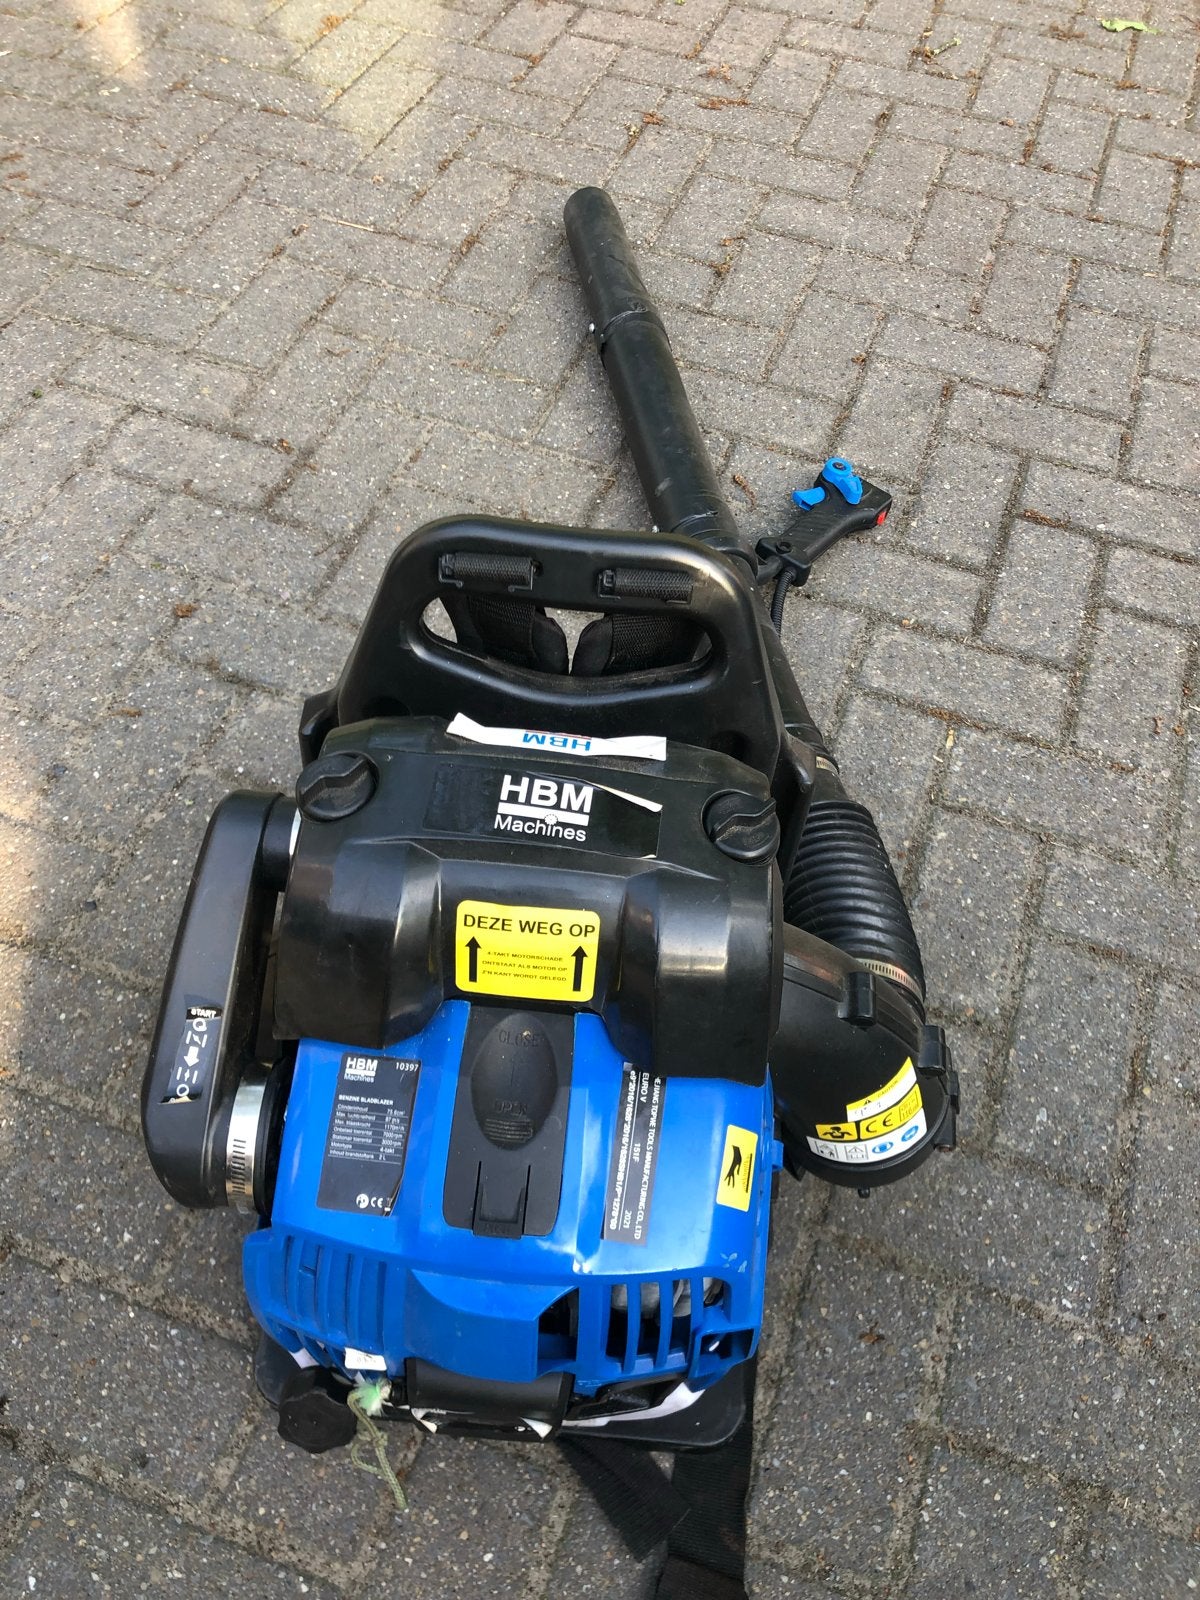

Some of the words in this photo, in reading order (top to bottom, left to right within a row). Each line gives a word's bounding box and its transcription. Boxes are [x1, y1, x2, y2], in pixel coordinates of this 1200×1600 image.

[522, 732, 591, 752] HBM
[499, 774, 594, 813] HBM
[494, 813, 587, 842] Machines
[463, 914, 513, 932] DEZE
[519, 920, 563, 936] WEG
[569, 924, 596, 938] OP
[482, 960, 516, 968] ONTSTAAT
[511, 953, 563, 962] MOTORSCHADE
[190, 1008, 217, 1019] START
[498, 1030, 539, 1047] CLOSE
[345, 1057, 378, 1072] HBM
[395, 1061, 419, 1072] 10397
[344, 1072, 375, 1083] Machines
[641, 1072, 650, 1095] EURO
[338, 1094, 360, 1102] BENZINE
[360, 1096, 394, 1106] BLADBLAZER
[866, 1112, 893, 1133] CE
[646, 1128, 656, 1151] TOOLS
[632, 1142, 641, 1163] 151F
[638, 1151, 653, 1210] MANUFACTURING
[623, 1210, 632, 1229] 2021
